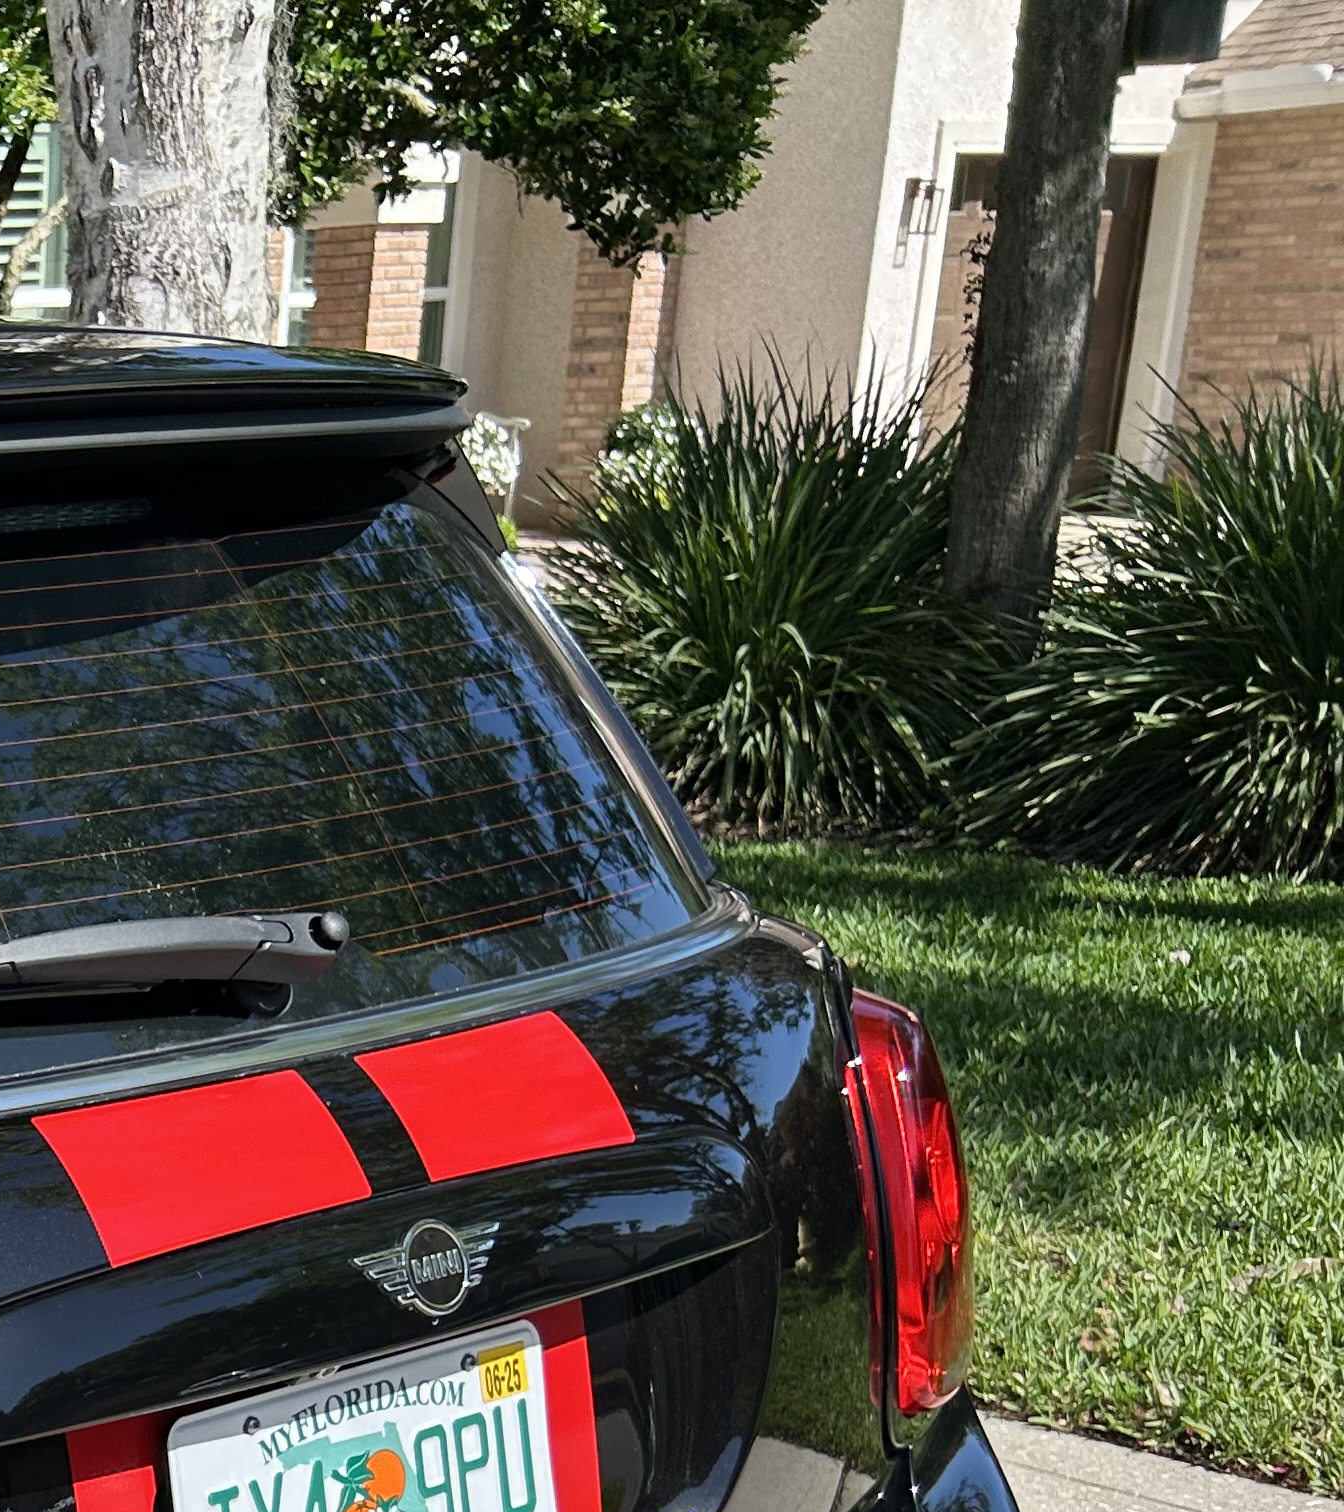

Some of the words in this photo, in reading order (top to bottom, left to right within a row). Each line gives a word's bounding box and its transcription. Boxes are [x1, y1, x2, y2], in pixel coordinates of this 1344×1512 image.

[410, 1248, 463, 1284] MINI
[485, 1358, 522, 1399] 06-25
[257, 1376, 465, 1466] MYFLORIDA.COM
